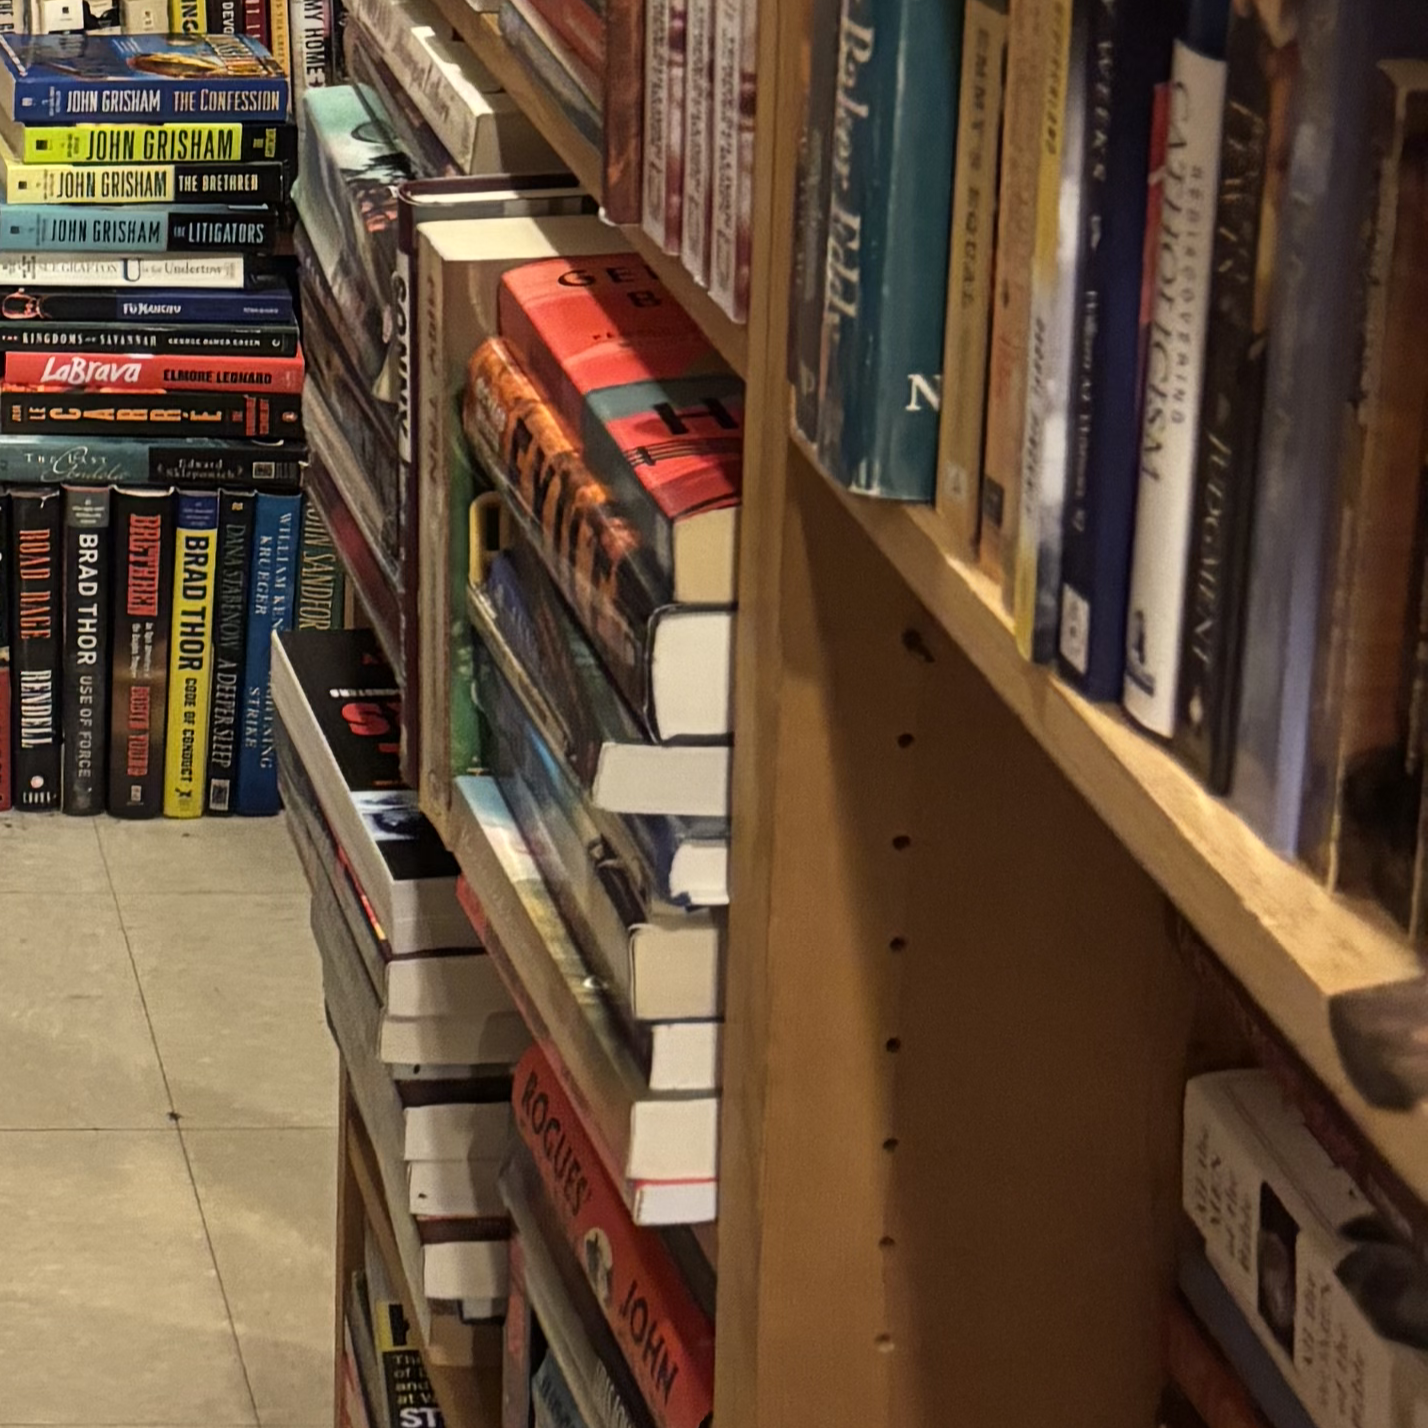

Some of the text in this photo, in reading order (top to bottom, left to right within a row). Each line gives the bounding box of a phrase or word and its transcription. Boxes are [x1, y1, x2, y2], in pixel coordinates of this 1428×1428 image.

[66, 89, 160, 114] JOHN GRISHAM
[85, 129, 233, 160] JOHN GRISHAM
[188, 223, 264, 243] LITIGATORS
[77, 535, 98, 664] BRAD THOR
